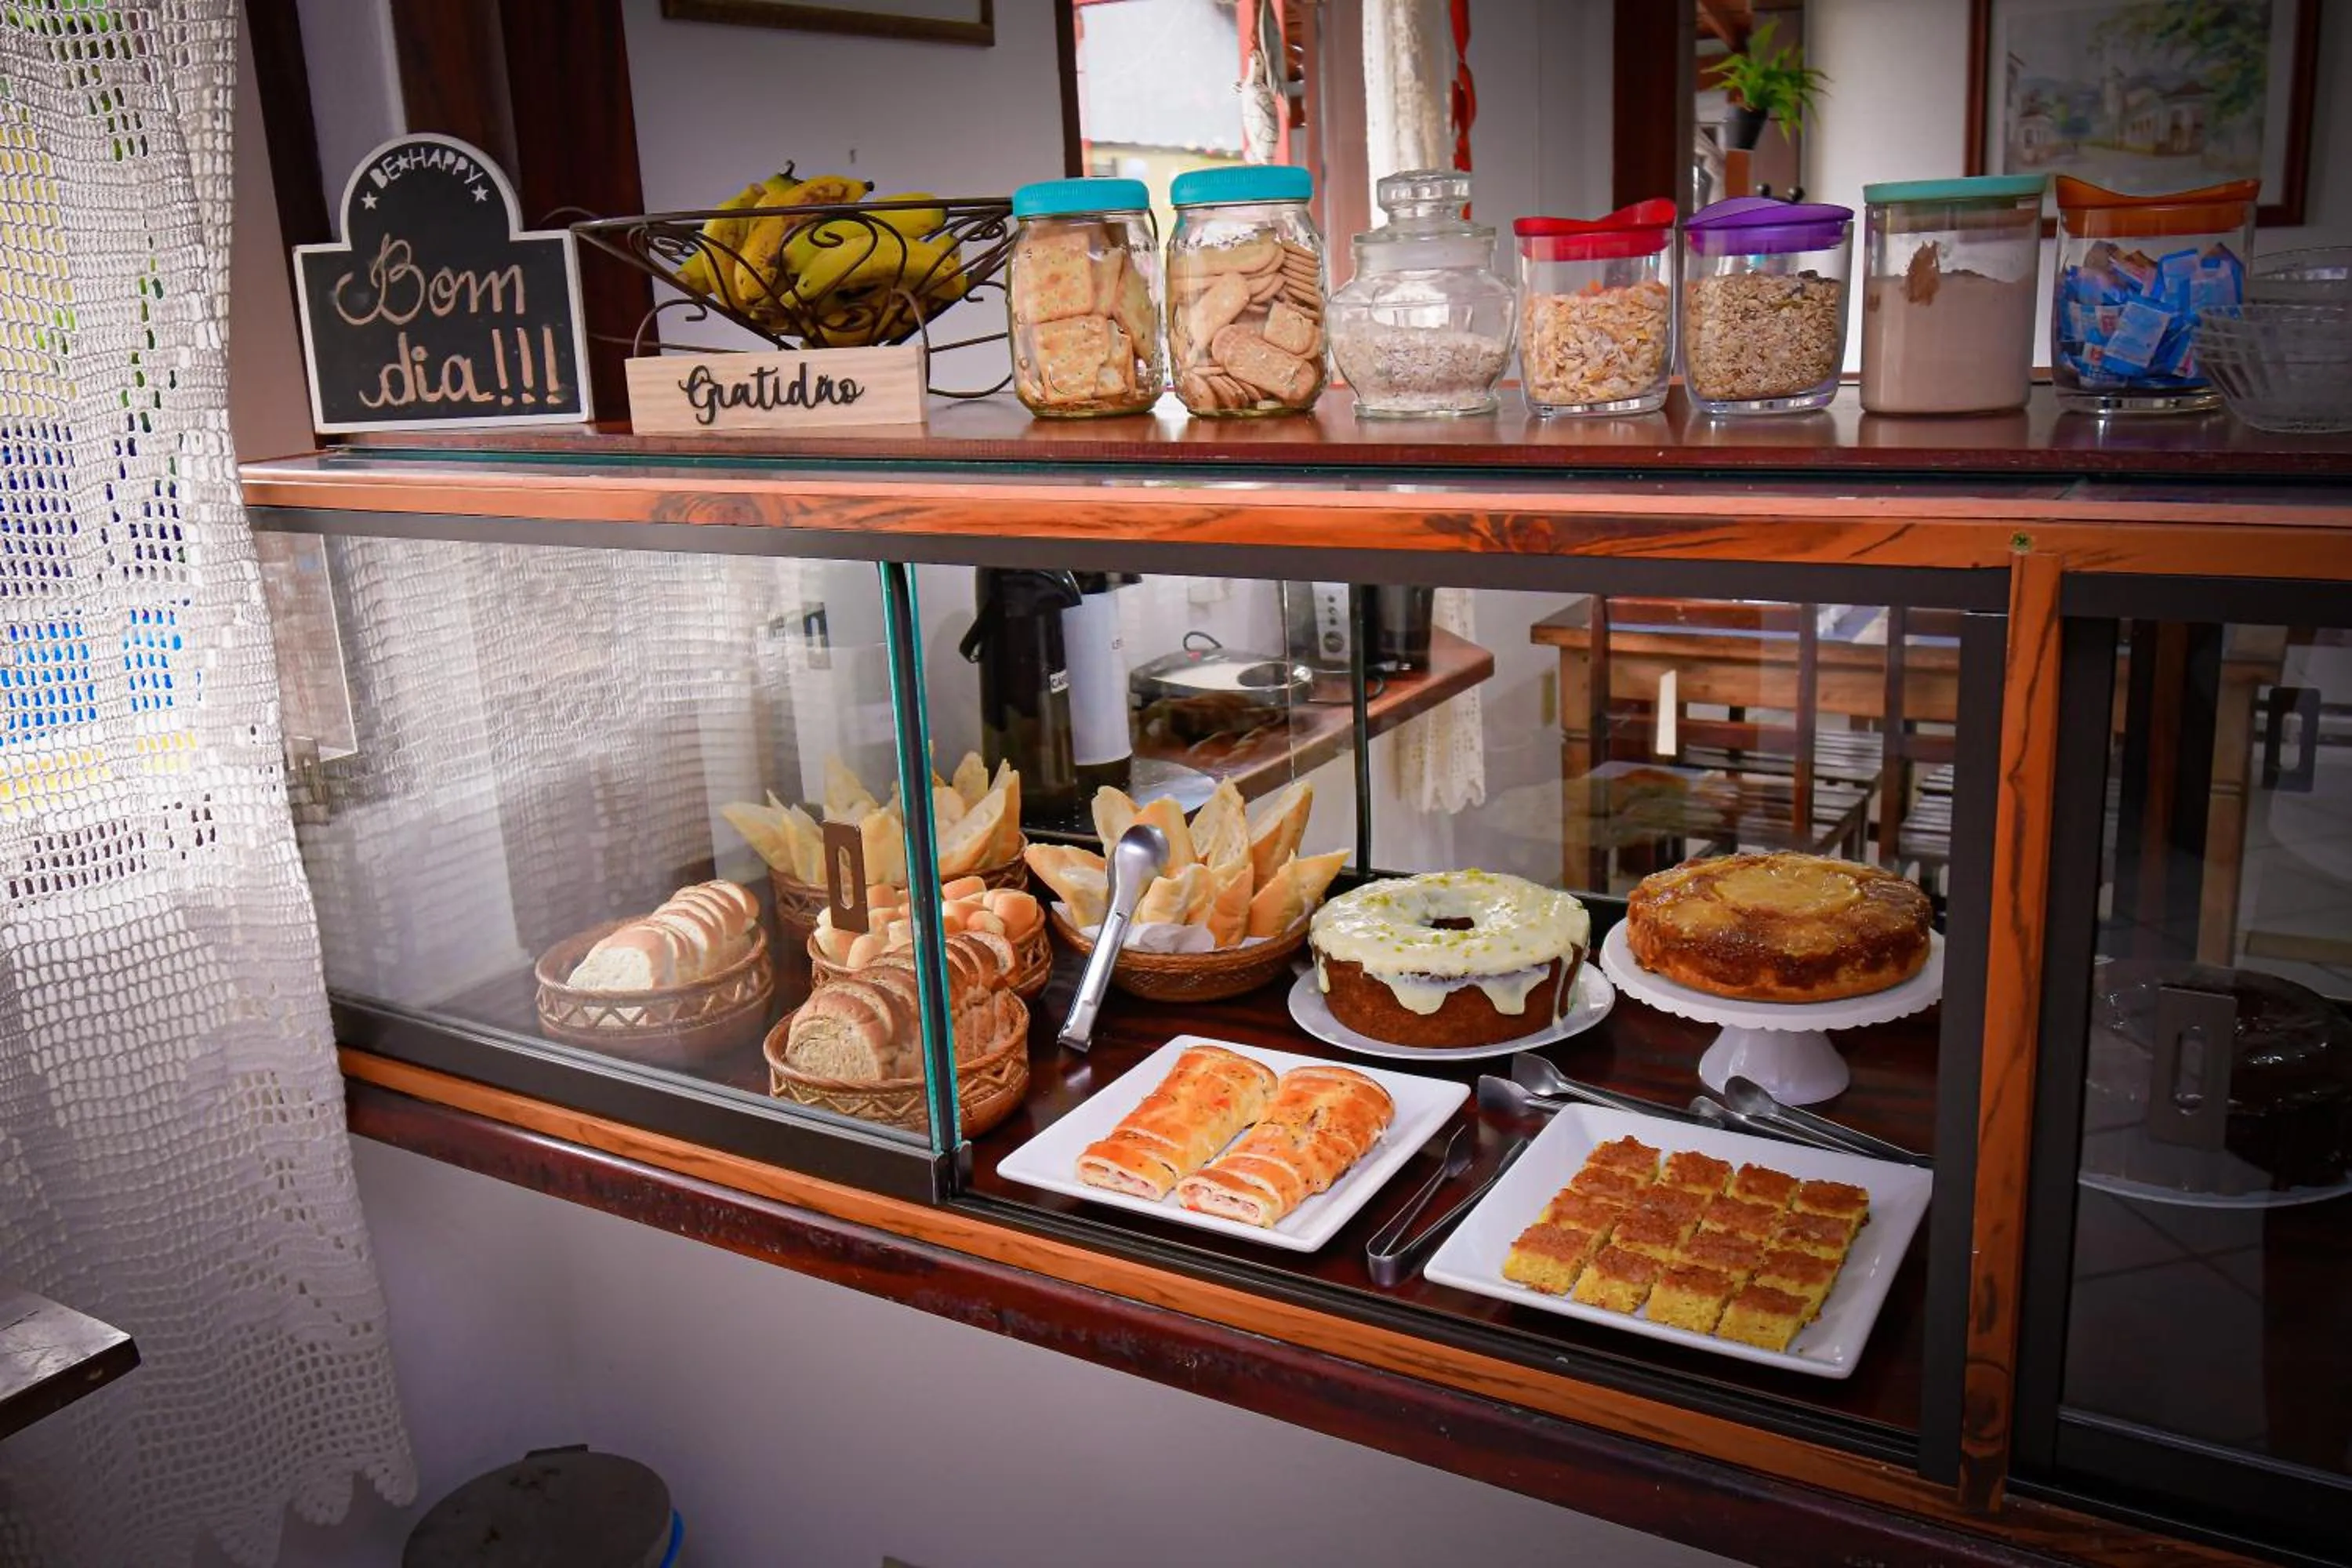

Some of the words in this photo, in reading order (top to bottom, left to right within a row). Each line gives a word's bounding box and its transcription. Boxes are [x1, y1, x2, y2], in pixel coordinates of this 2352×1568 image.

[369, 156, 401, 188] BE
[408, 147, 485, 185] HAPPY
[335, 233, 525, 325] Bom
[358, 324, 563, 408] dia!!!
[678, 362, 865, 425] Gratidão
